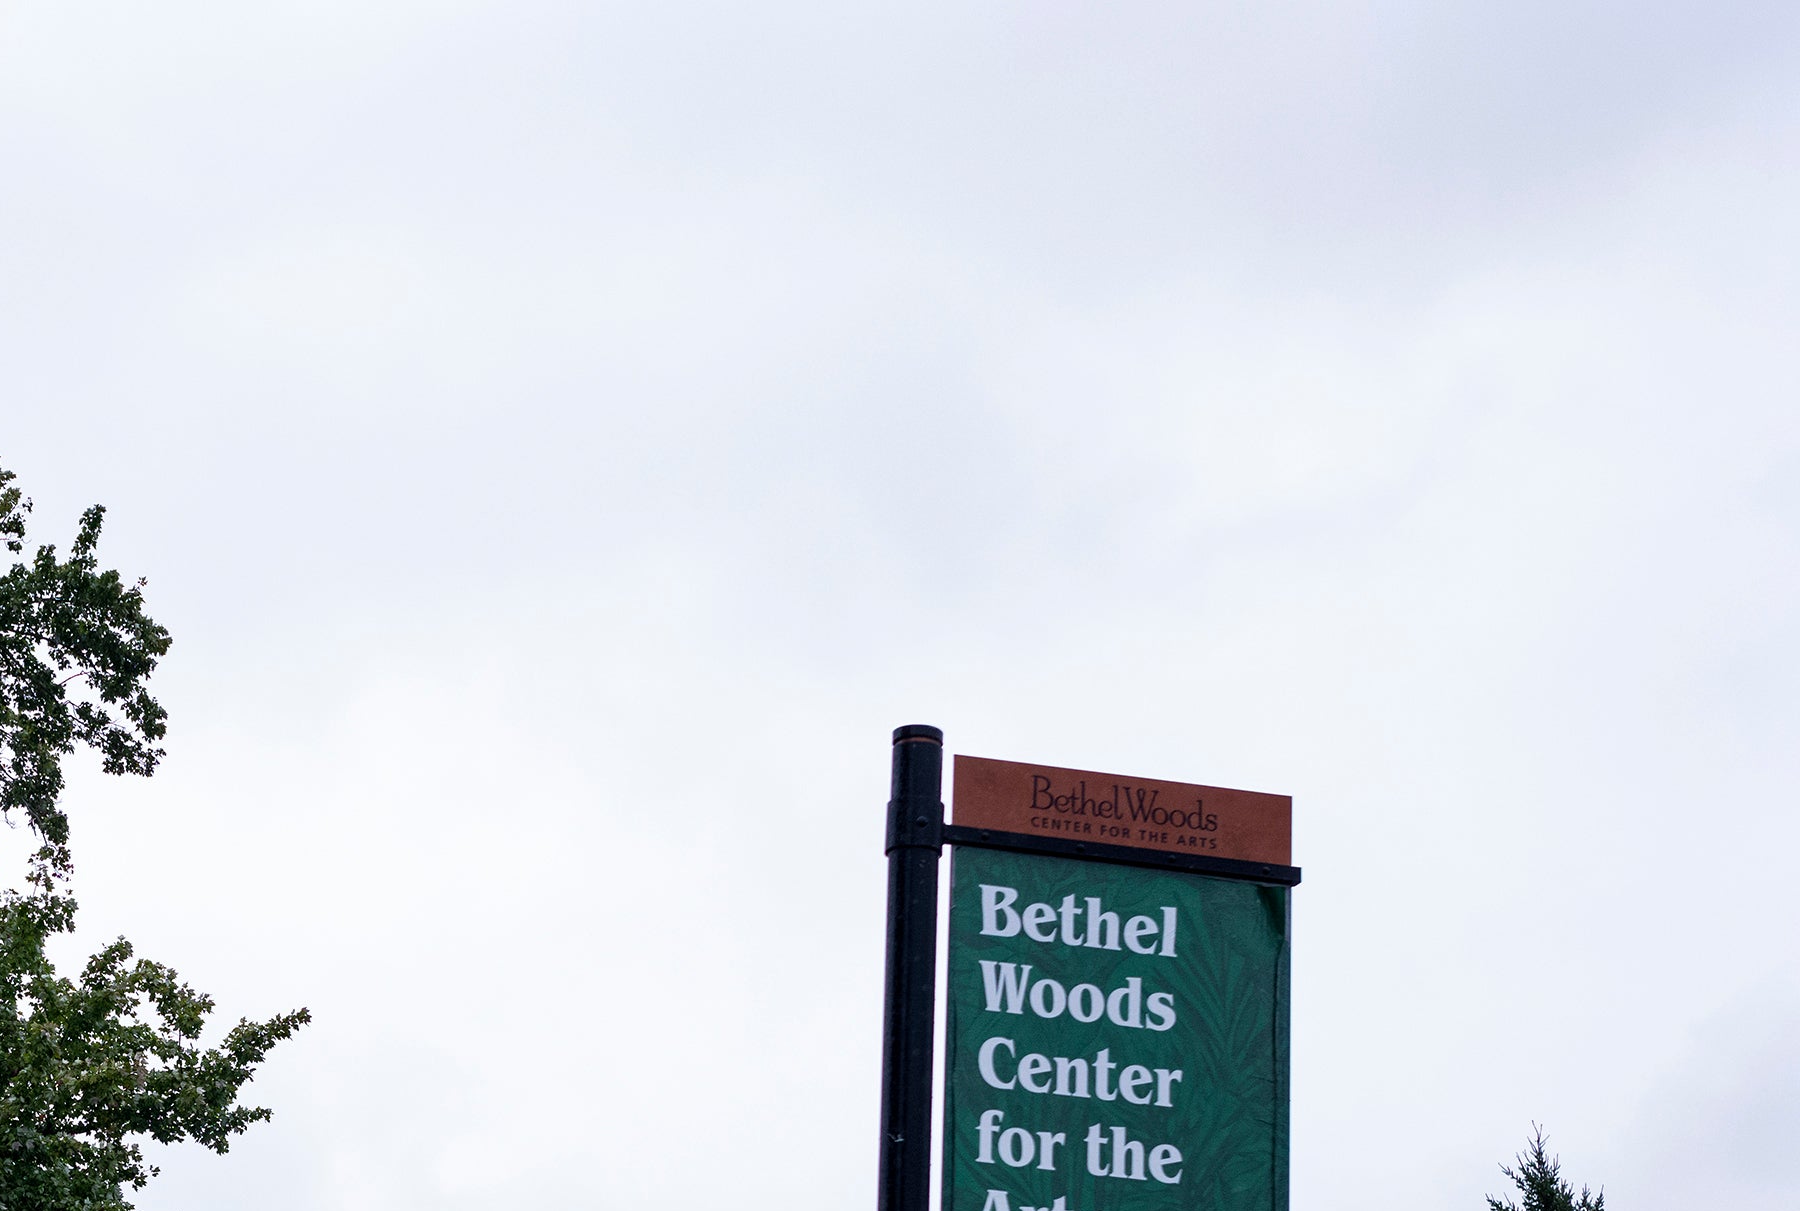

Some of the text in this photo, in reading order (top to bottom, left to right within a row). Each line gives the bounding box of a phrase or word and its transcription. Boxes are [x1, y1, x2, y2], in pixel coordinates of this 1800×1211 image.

[1029, 774, 1218, 832] Bethel Woods
[1030, 816, 1217, 850] CENTER FOR THE ARTS
[978, 884, 1179, 958] Bethel
[978, 959, 1177, 1032] Woods
[977, 1036, 1184, 1108] Center
[975, 1109, 1184, 1185] for the
